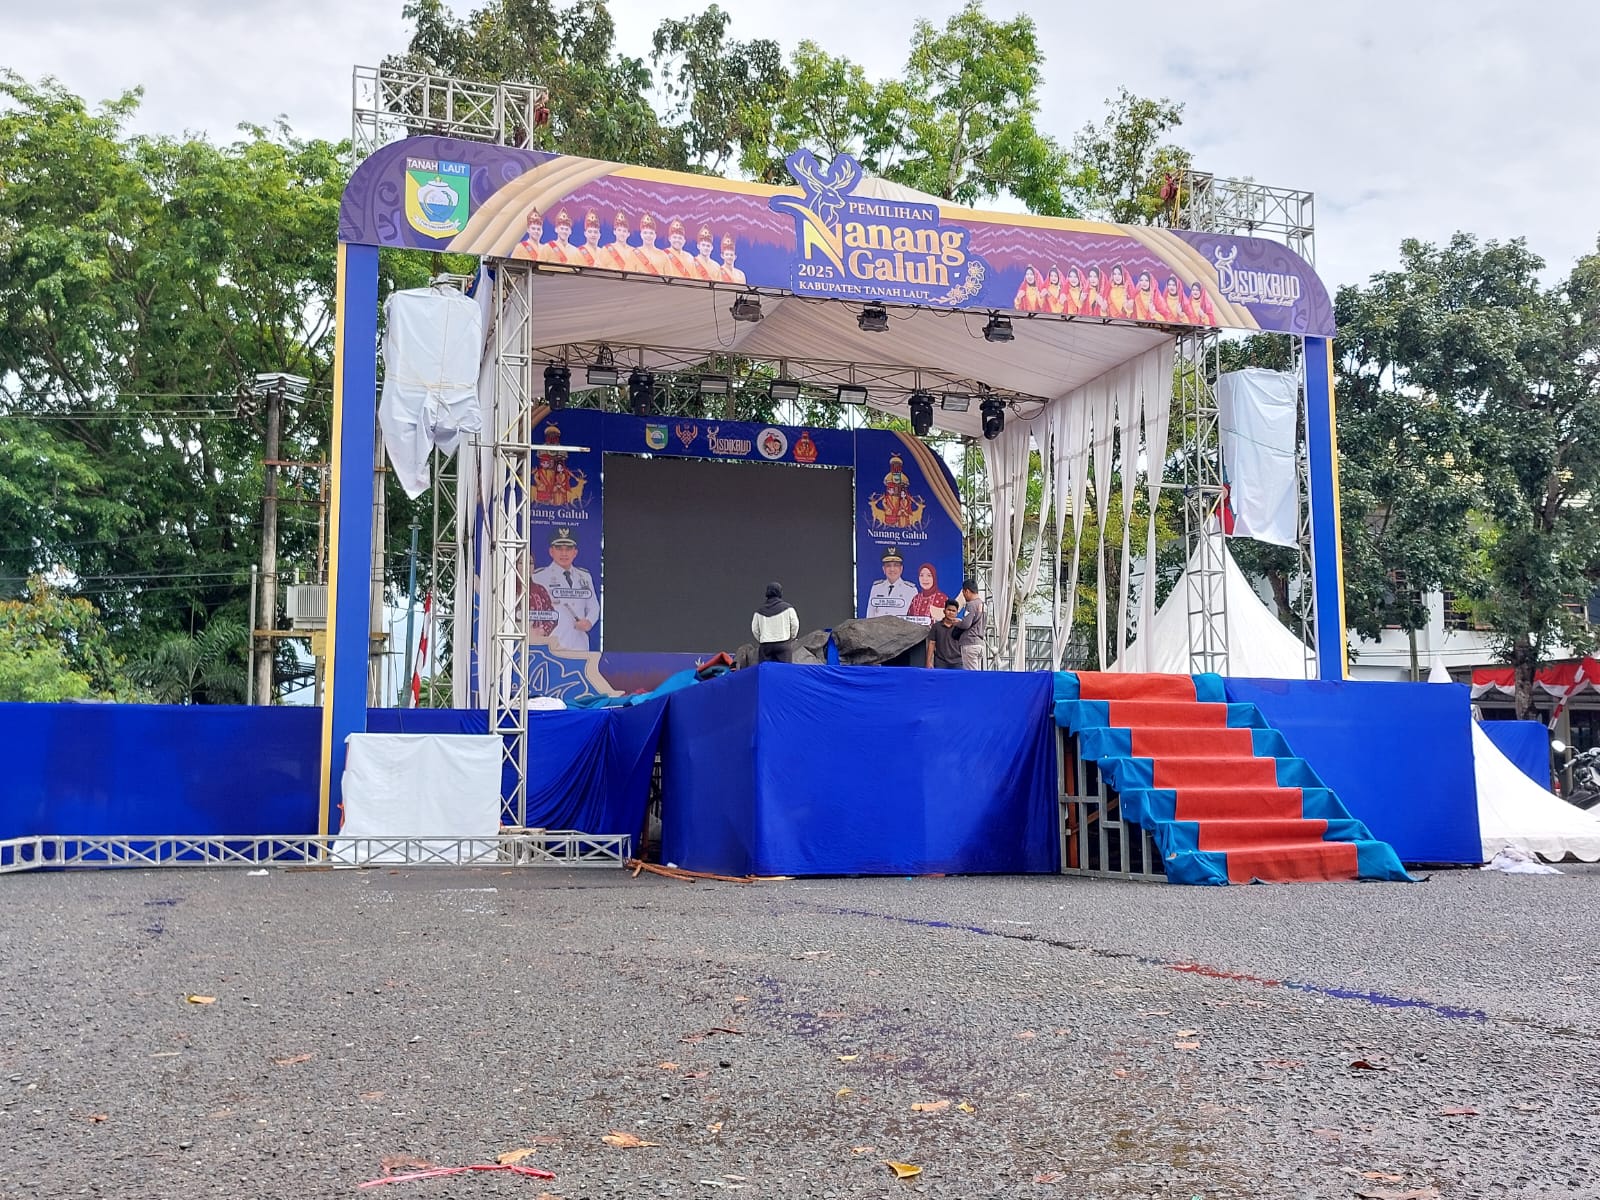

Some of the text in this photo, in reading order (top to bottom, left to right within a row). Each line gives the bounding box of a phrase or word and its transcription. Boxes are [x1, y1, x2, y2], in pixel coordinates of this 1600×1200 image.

[407, 159, 466, 174] TANAH LAUT
[849, 202, 933, 221] PEMILIHAN
[779, 201, 965, 278] Nanang
[798, 264, 834, 278] 2025
[848, 250, 950, 286] Galuh
[799, 281, 930, 299] KABUPATEN TANAH LAUT
[1215, 264, 1301, 299] DISDIKBUD
[557, 509, 589, 520] Galuh
[867, 528, 928, 541] Nanang Galuh
